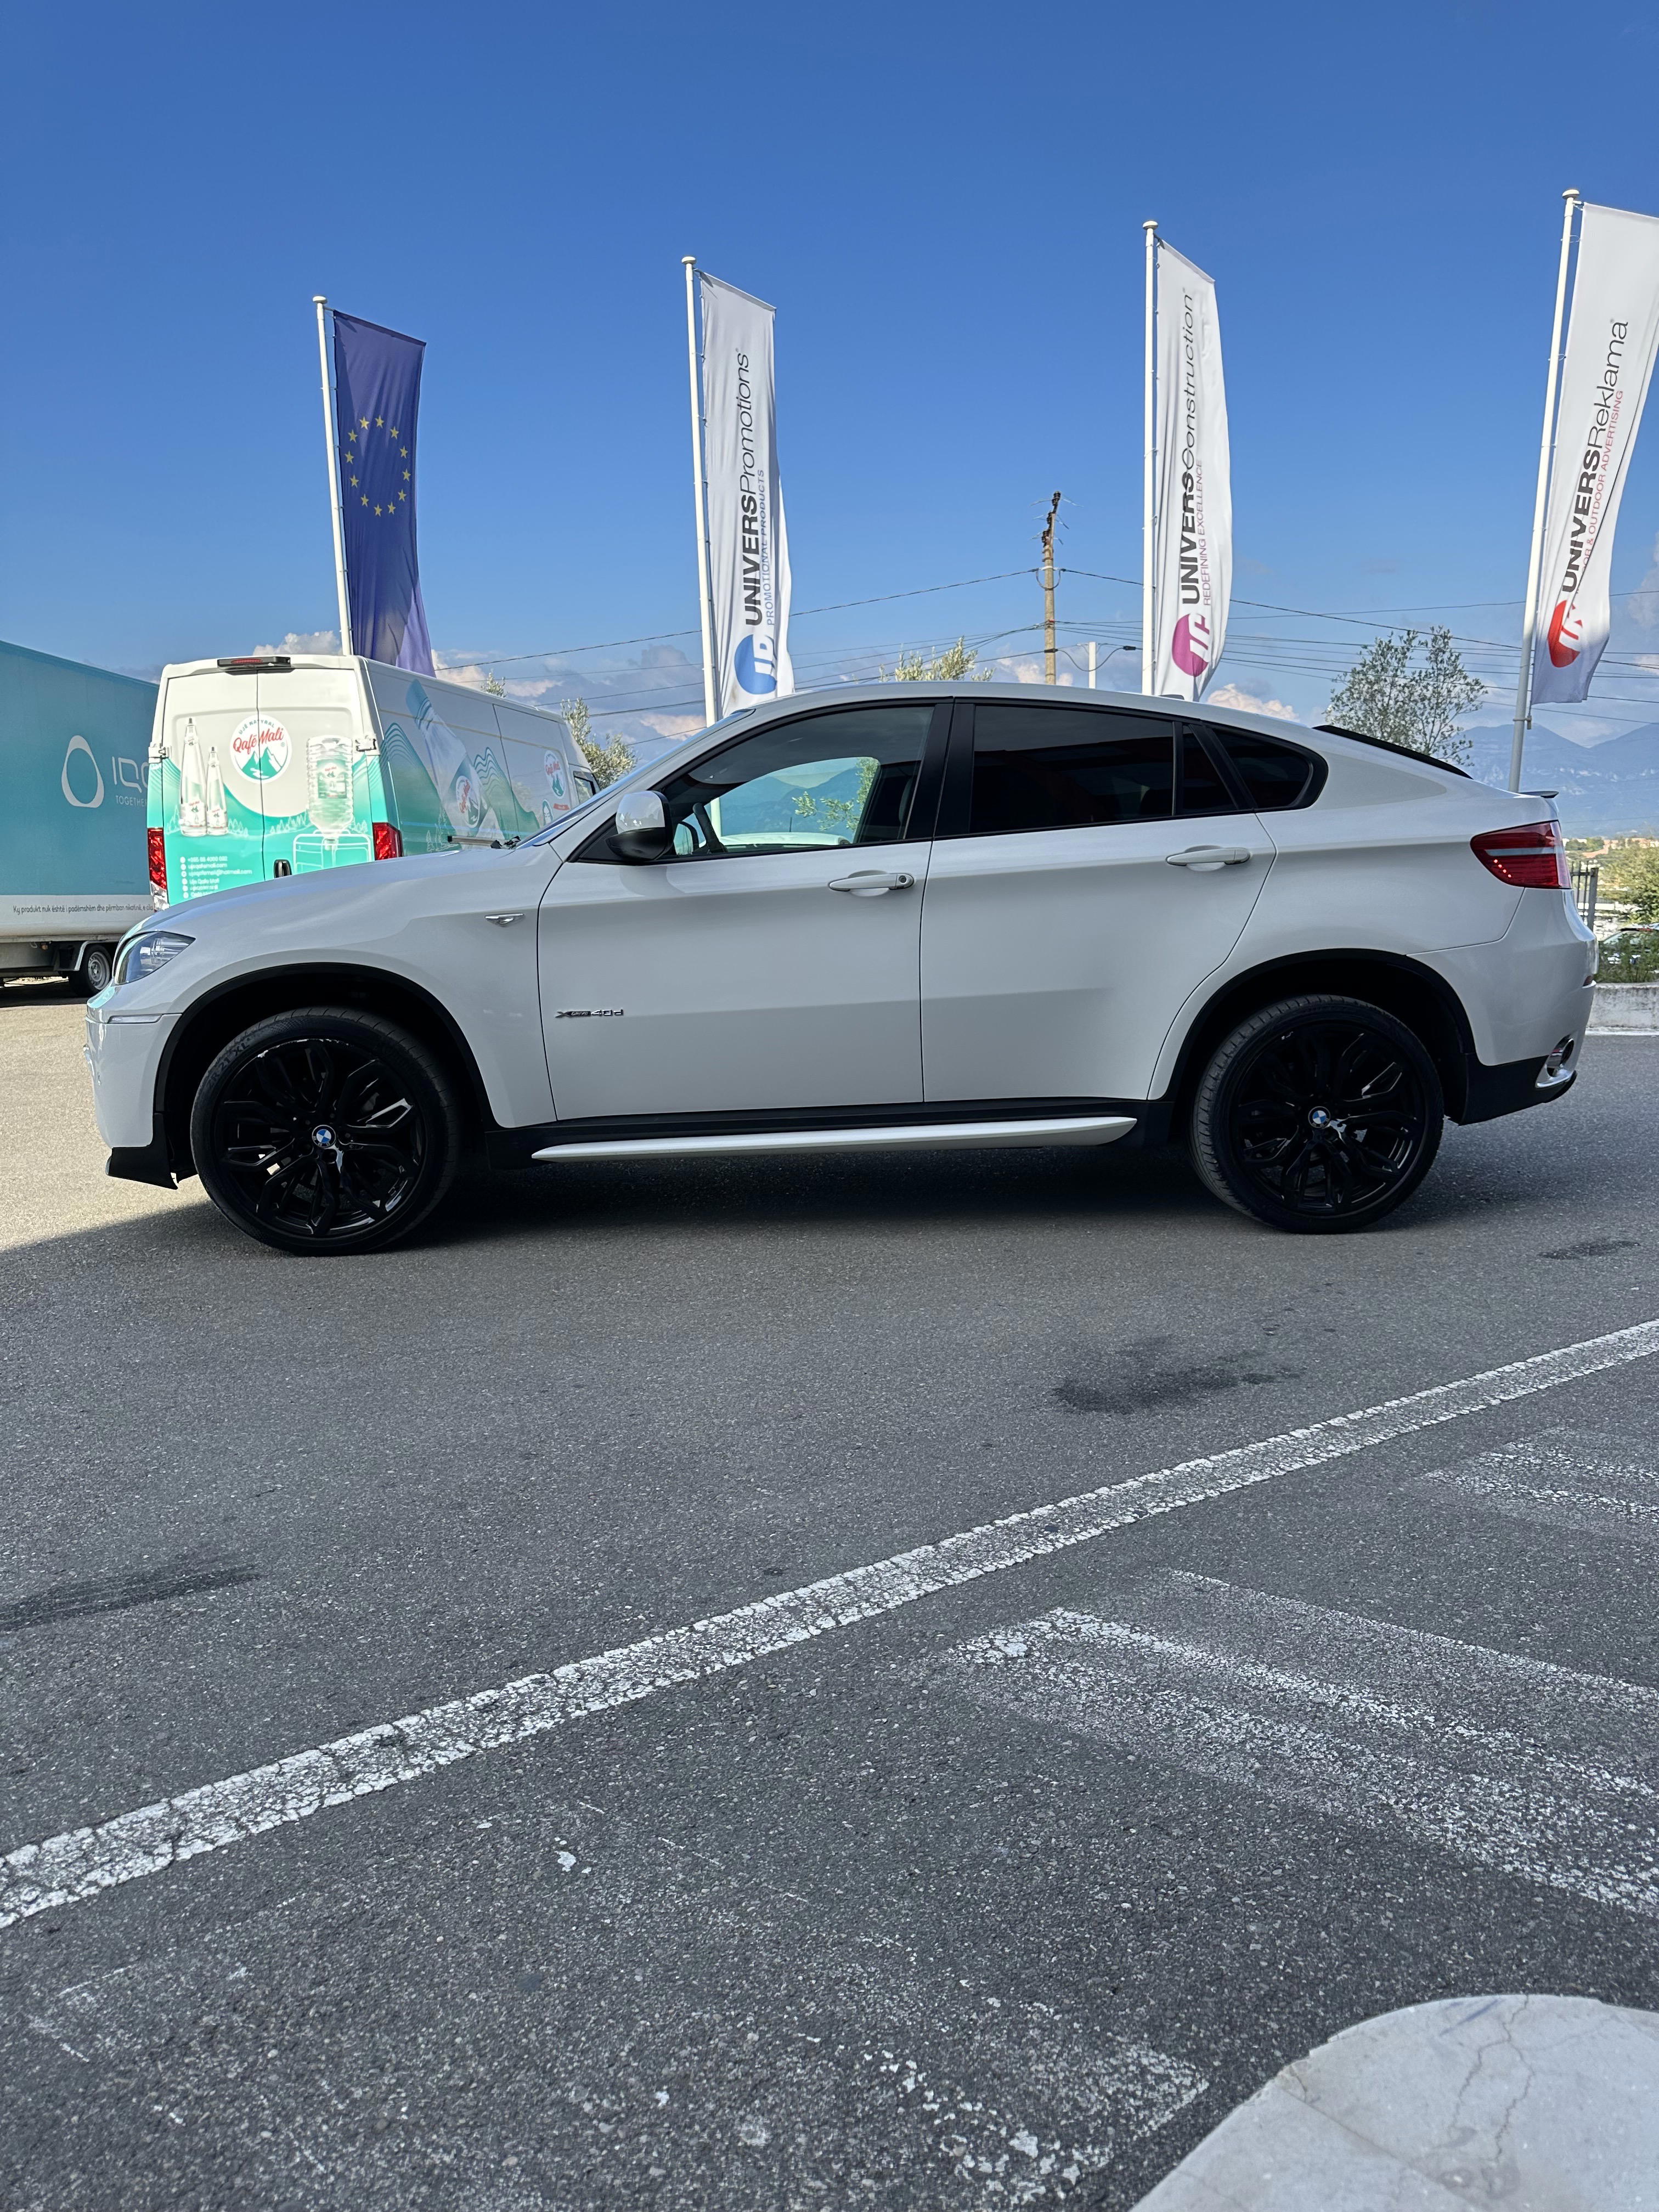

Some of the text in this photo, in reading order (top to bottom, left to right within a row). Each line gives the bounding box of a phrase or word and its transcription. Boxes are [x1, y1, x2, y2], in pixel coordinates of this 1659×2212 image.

[736, 353, 763, 626] UNIVERSPromotions
[1562, 321, 1628, 593] UNIVERSReklama
[1588, 473, 1606, 534] OUTDOOR
[1601, 390, 1623, 471] ADVERTISING
[758, 469, 775, 626] PROMOTIONAL PRODUCTS
[1195, 460, 1211, 606] REDEFINING EXCELLENCE
[259, 727, 284, 744] Mali
[13, 905, 20, 915] Ky
[21, 905, 41, 915] produkt
